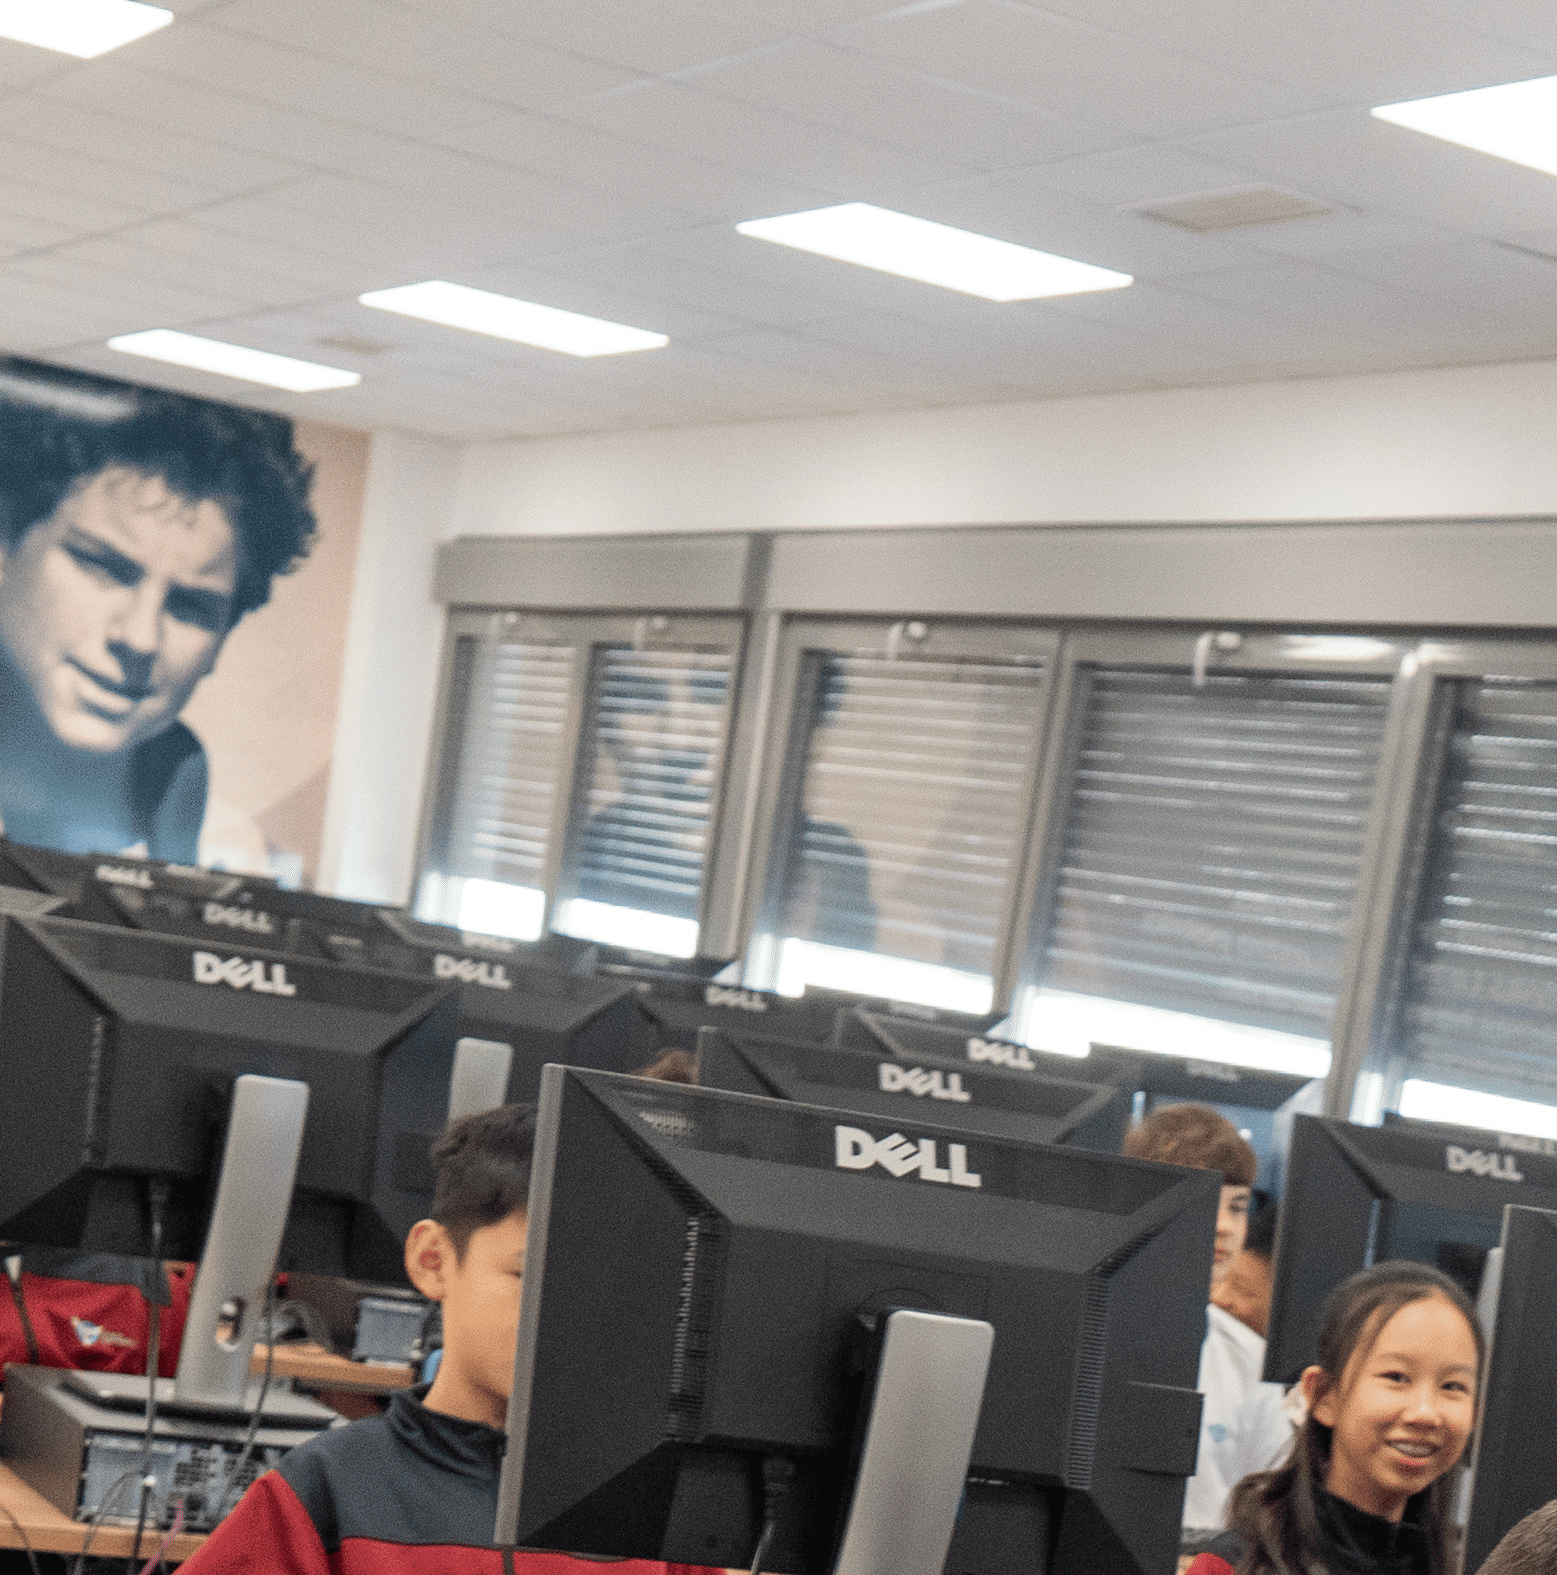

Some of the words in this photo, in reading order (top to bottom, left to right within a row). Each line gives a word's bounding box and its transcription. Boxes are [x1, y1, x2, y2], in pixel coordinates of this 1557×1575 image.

[203, 903, 273, 933] DELL
[193, 951, 297, 997] DELL
[434, 953, 512, 990] DELL
[967, 1037, 1036, 1071] DELL
[878, 1062, 972, 1101] DELL
[835, 1125, 982, 1187] DELL
[1447, 1146, 1523, 1181] DELL
